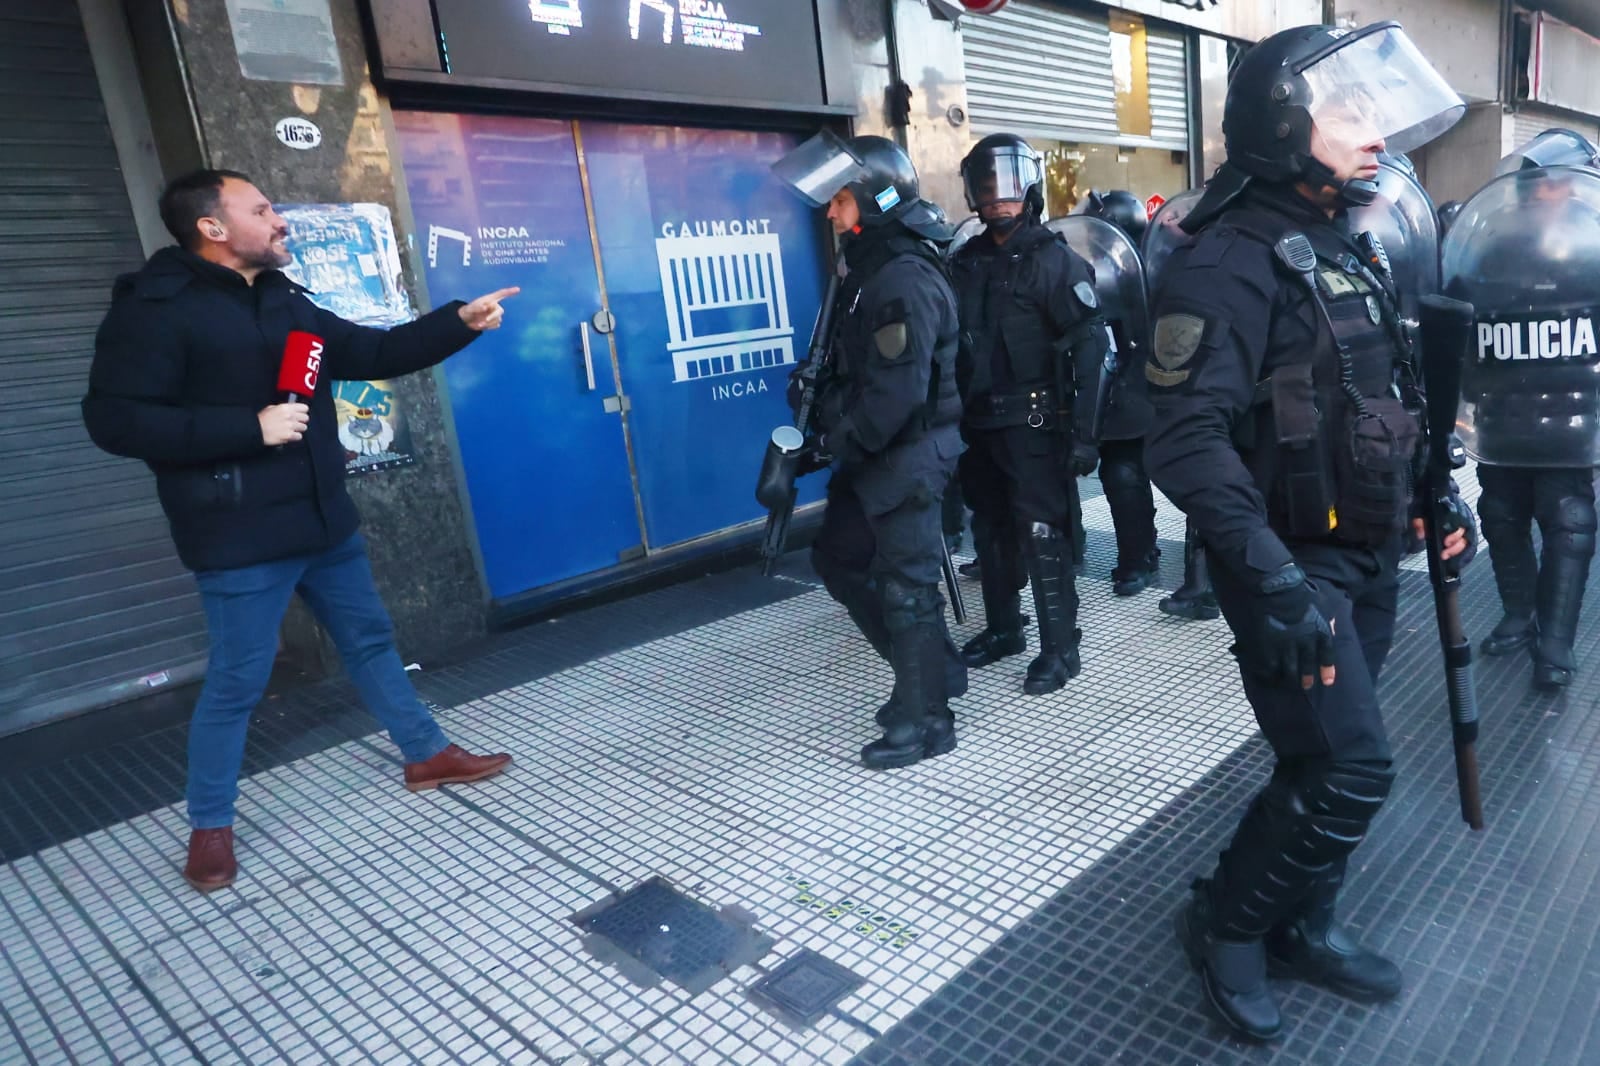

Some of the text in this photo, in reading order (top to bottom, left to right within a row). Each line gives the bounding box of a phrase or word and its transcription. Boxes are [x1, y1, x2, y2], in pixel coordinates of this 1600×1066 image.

[477, 226, 529, 239] INCAA
[661, 218, 770, 238] GAUMONT
[481, 239, 565, 248] INSTITUTO NACIONAL
[481, 249, 493, 257] DE
[495, 248, 515, 257] CINE
[523, 247, 550, 256] ARTES
[483, 255, 548, 265] AUDIOVISUALES
[304, 340, 324, 390] C5N
[711, 378, 768, 401] INCAA
